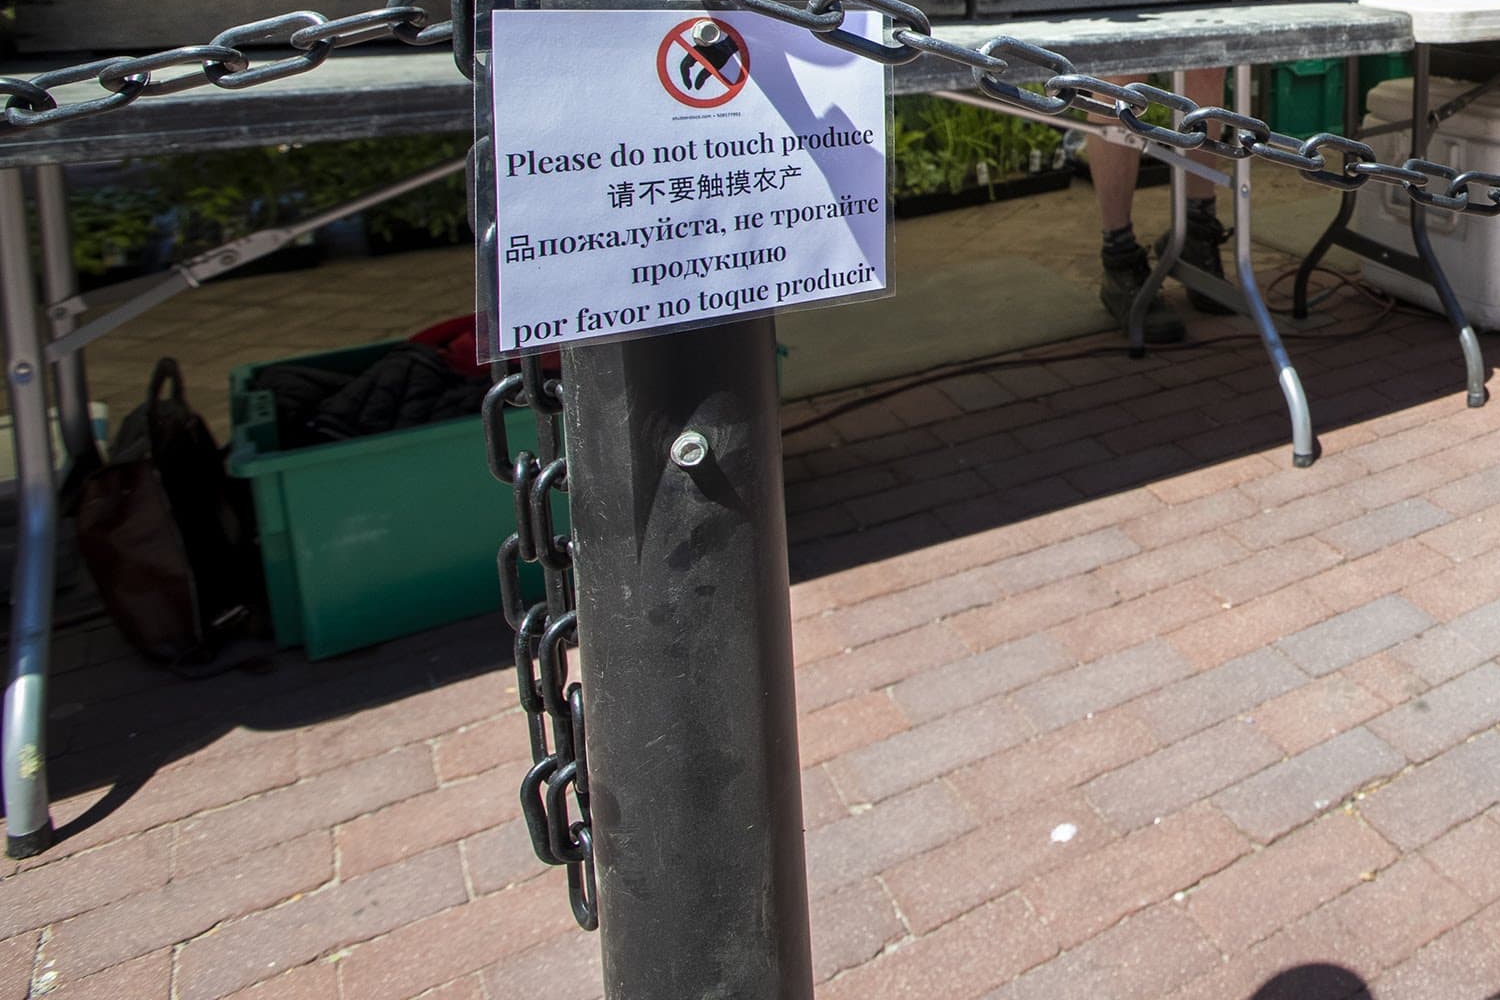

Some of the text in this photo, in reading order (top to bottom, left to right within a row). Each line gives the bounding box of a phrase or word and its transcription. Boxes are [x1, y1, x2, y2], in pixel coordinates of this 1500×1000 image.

[506, 126, 874, 177] Please do not touch produce
[608, 164, 802, 209] 请不要触摸农产
[734, 212, 763, 231] не
[771, 195, 879, 228] трогайте
[632, 246, 786, 285] продукцию
[513, 264, 876, 348] por favor no toque producir
